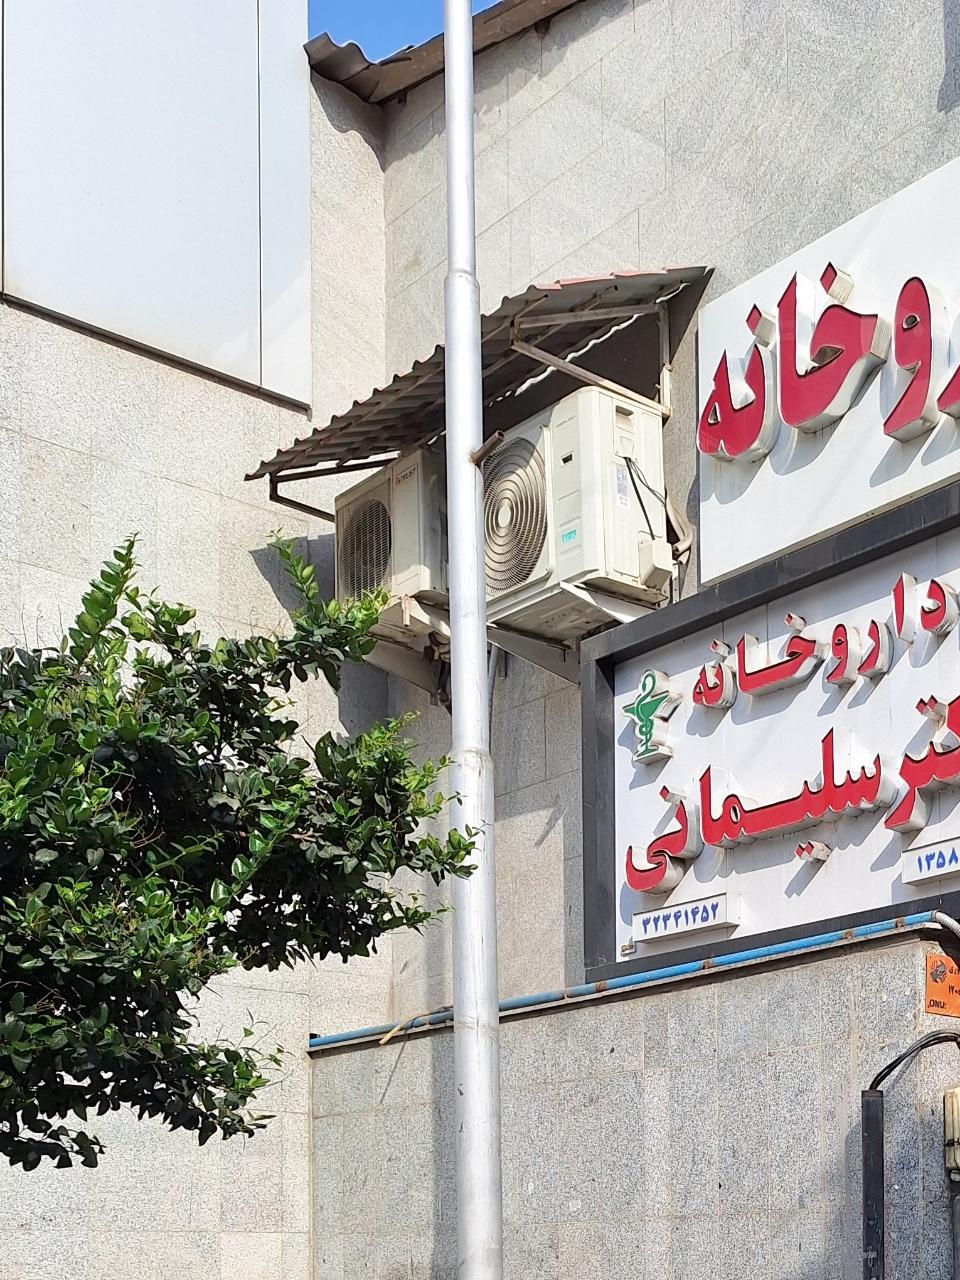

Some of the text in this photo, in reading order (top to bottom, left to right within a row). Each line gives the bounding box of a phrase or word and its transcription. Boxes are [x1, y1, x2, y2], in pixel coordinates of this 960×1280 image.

[692, 573, 957, 708] داروخانه
[625, 728, 892, 895] سلیمانی
[916, 844, 960, 873] ۱۳۵۸
[641, 902, 720, 936] ۳۲۳۴۱۴۵۲
